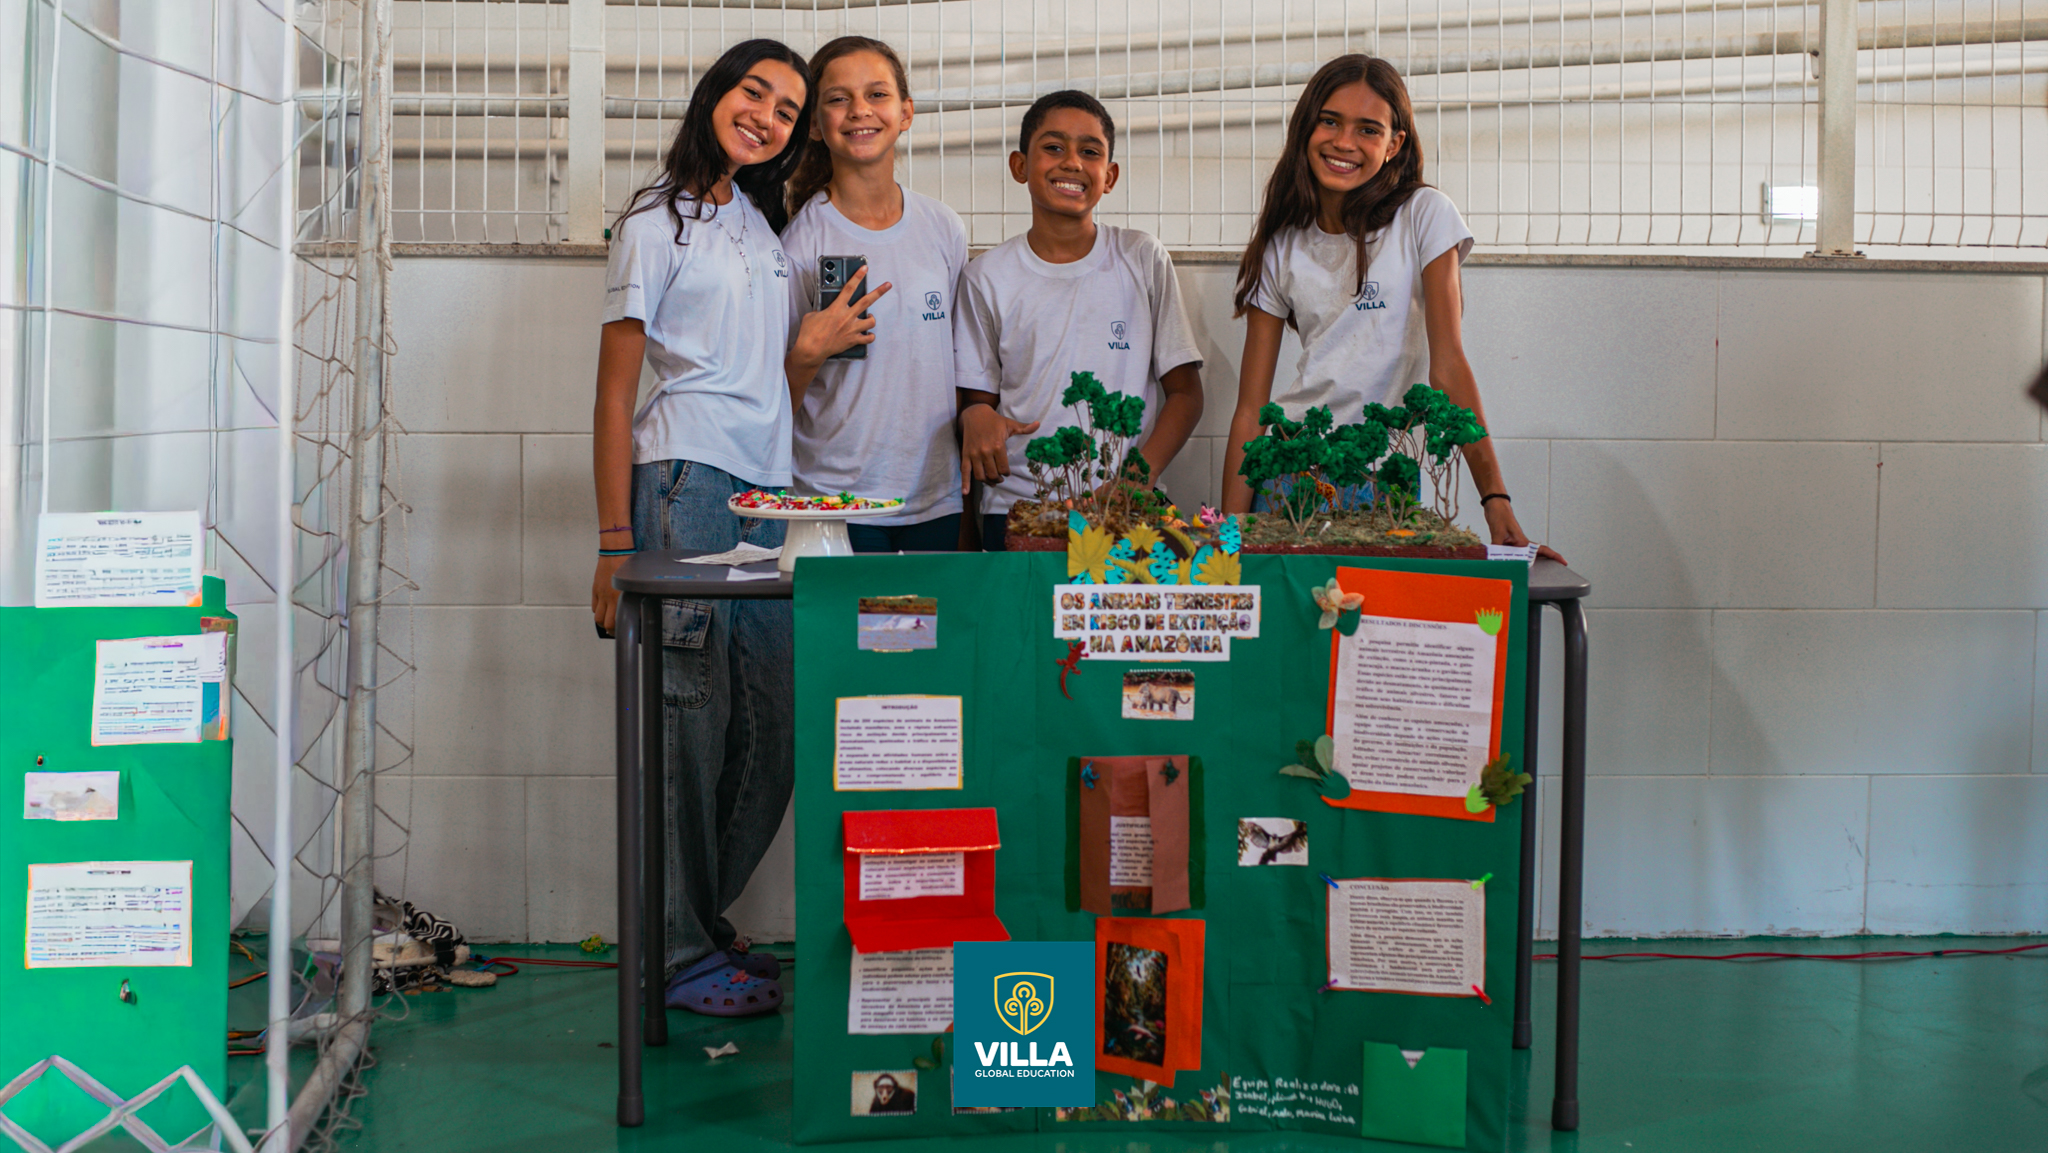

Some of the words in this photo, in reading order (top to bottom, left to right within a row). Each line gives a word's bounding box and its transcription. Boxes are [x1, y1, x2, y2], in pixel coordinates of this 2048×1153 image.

[1355, 300, 1386, 310] VILLA
[922, 312, 945, 321] VILLA
[1108, 342, 1130, 350] VILLA
[1060, 592, 1085, 610] OS
[1089, 592, 1160, 610] ANIMAIS
[1164, 592, 1254, 610] TERRESTRES
[1062, 614, 1085, 631] EM
[1090, 614, 1140, 631] RISCO
[1145, 614, 1164, 630] DE
[1168, 612, 1251, 634] EXTINÇÃO
[1090, 635, 1116, 652] NA
[1120, 632, 1222, 653] AMAZÔNIA
[1232, 1076, 1269, 1091] Equipe
